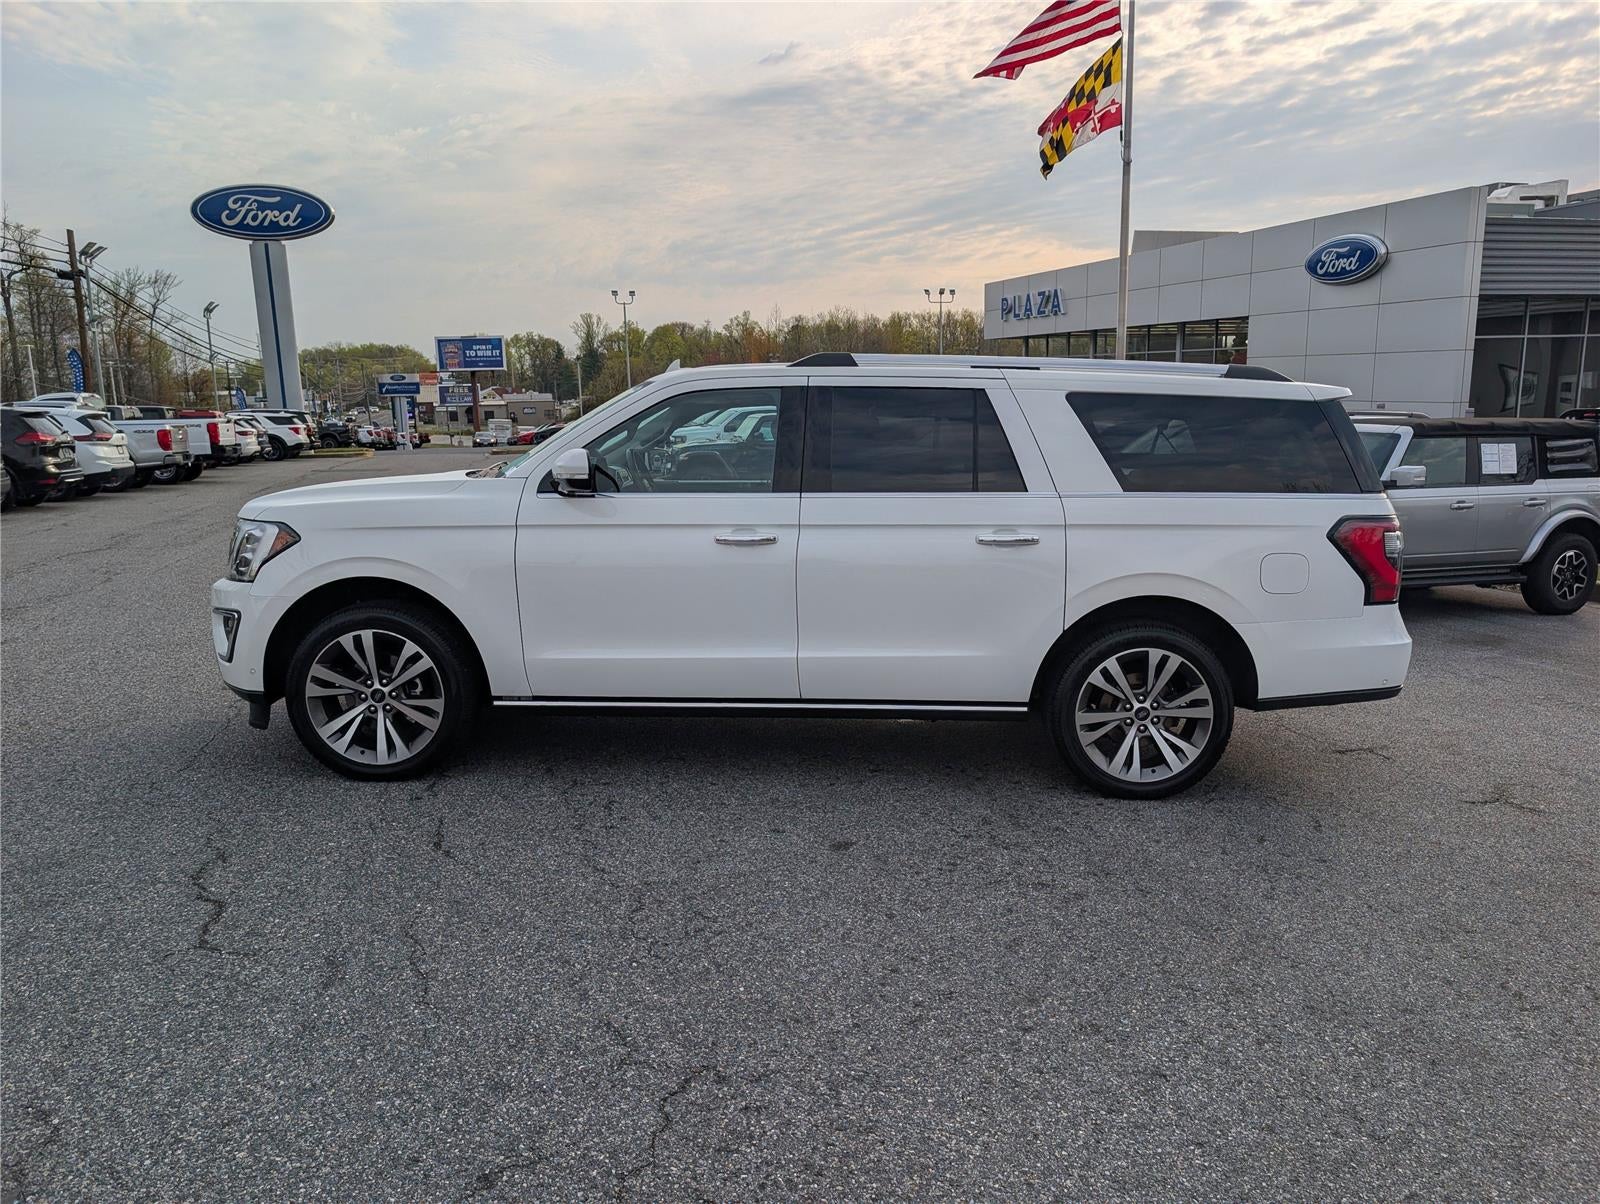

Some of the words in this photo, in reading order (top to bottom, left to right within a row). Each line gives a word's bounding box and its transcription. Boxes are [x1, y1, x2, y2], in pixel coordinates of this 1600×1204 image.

[220, 194, 302, 227] Ford
[1316, 246, 1361, 275] Ford
[1001, 288, 1065, 321] PLAZA
